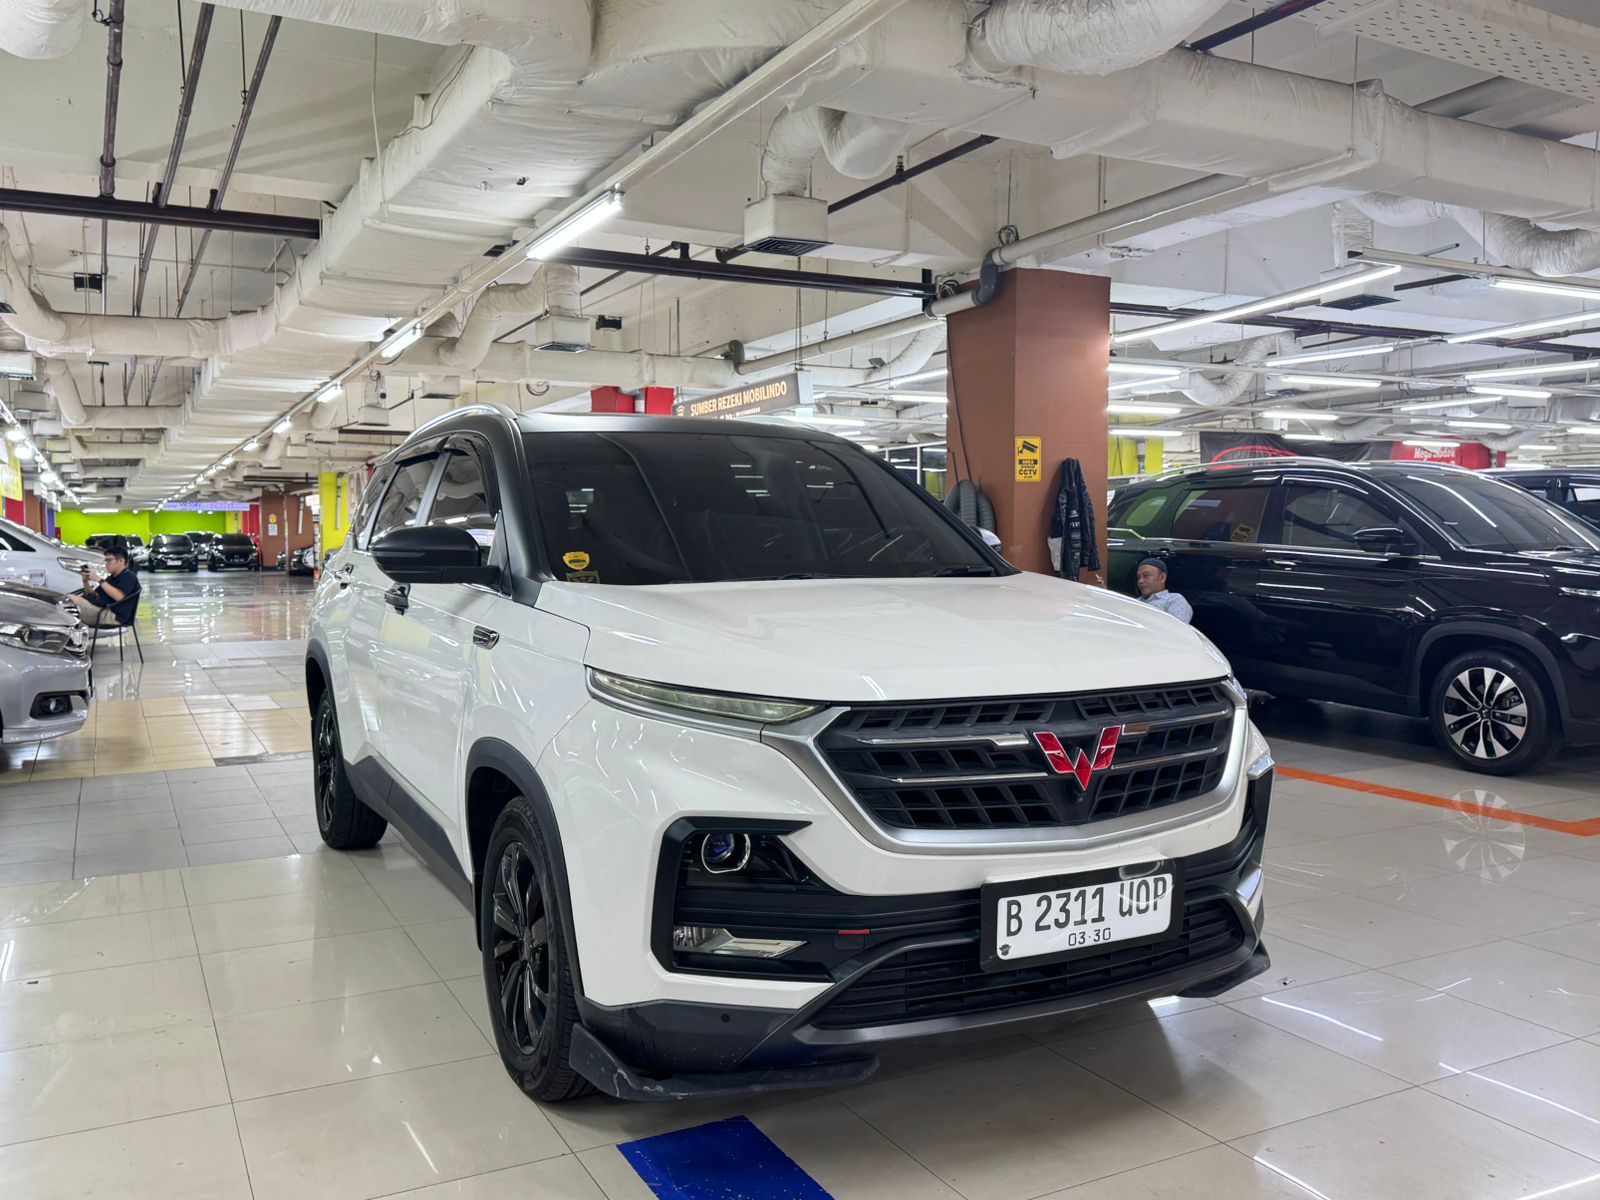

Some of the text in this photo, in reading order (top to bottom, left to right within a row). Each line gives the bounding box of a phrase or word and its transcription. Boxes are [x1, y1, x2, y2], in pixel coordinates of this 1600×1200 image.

[690, 399, 717, 416] SUMBER
[718, 393, 742, 410] REZEKI
[743, 381, 787, 404] MOBILINDO
[1006, 876, 1167, 937] B 2311 UOP
